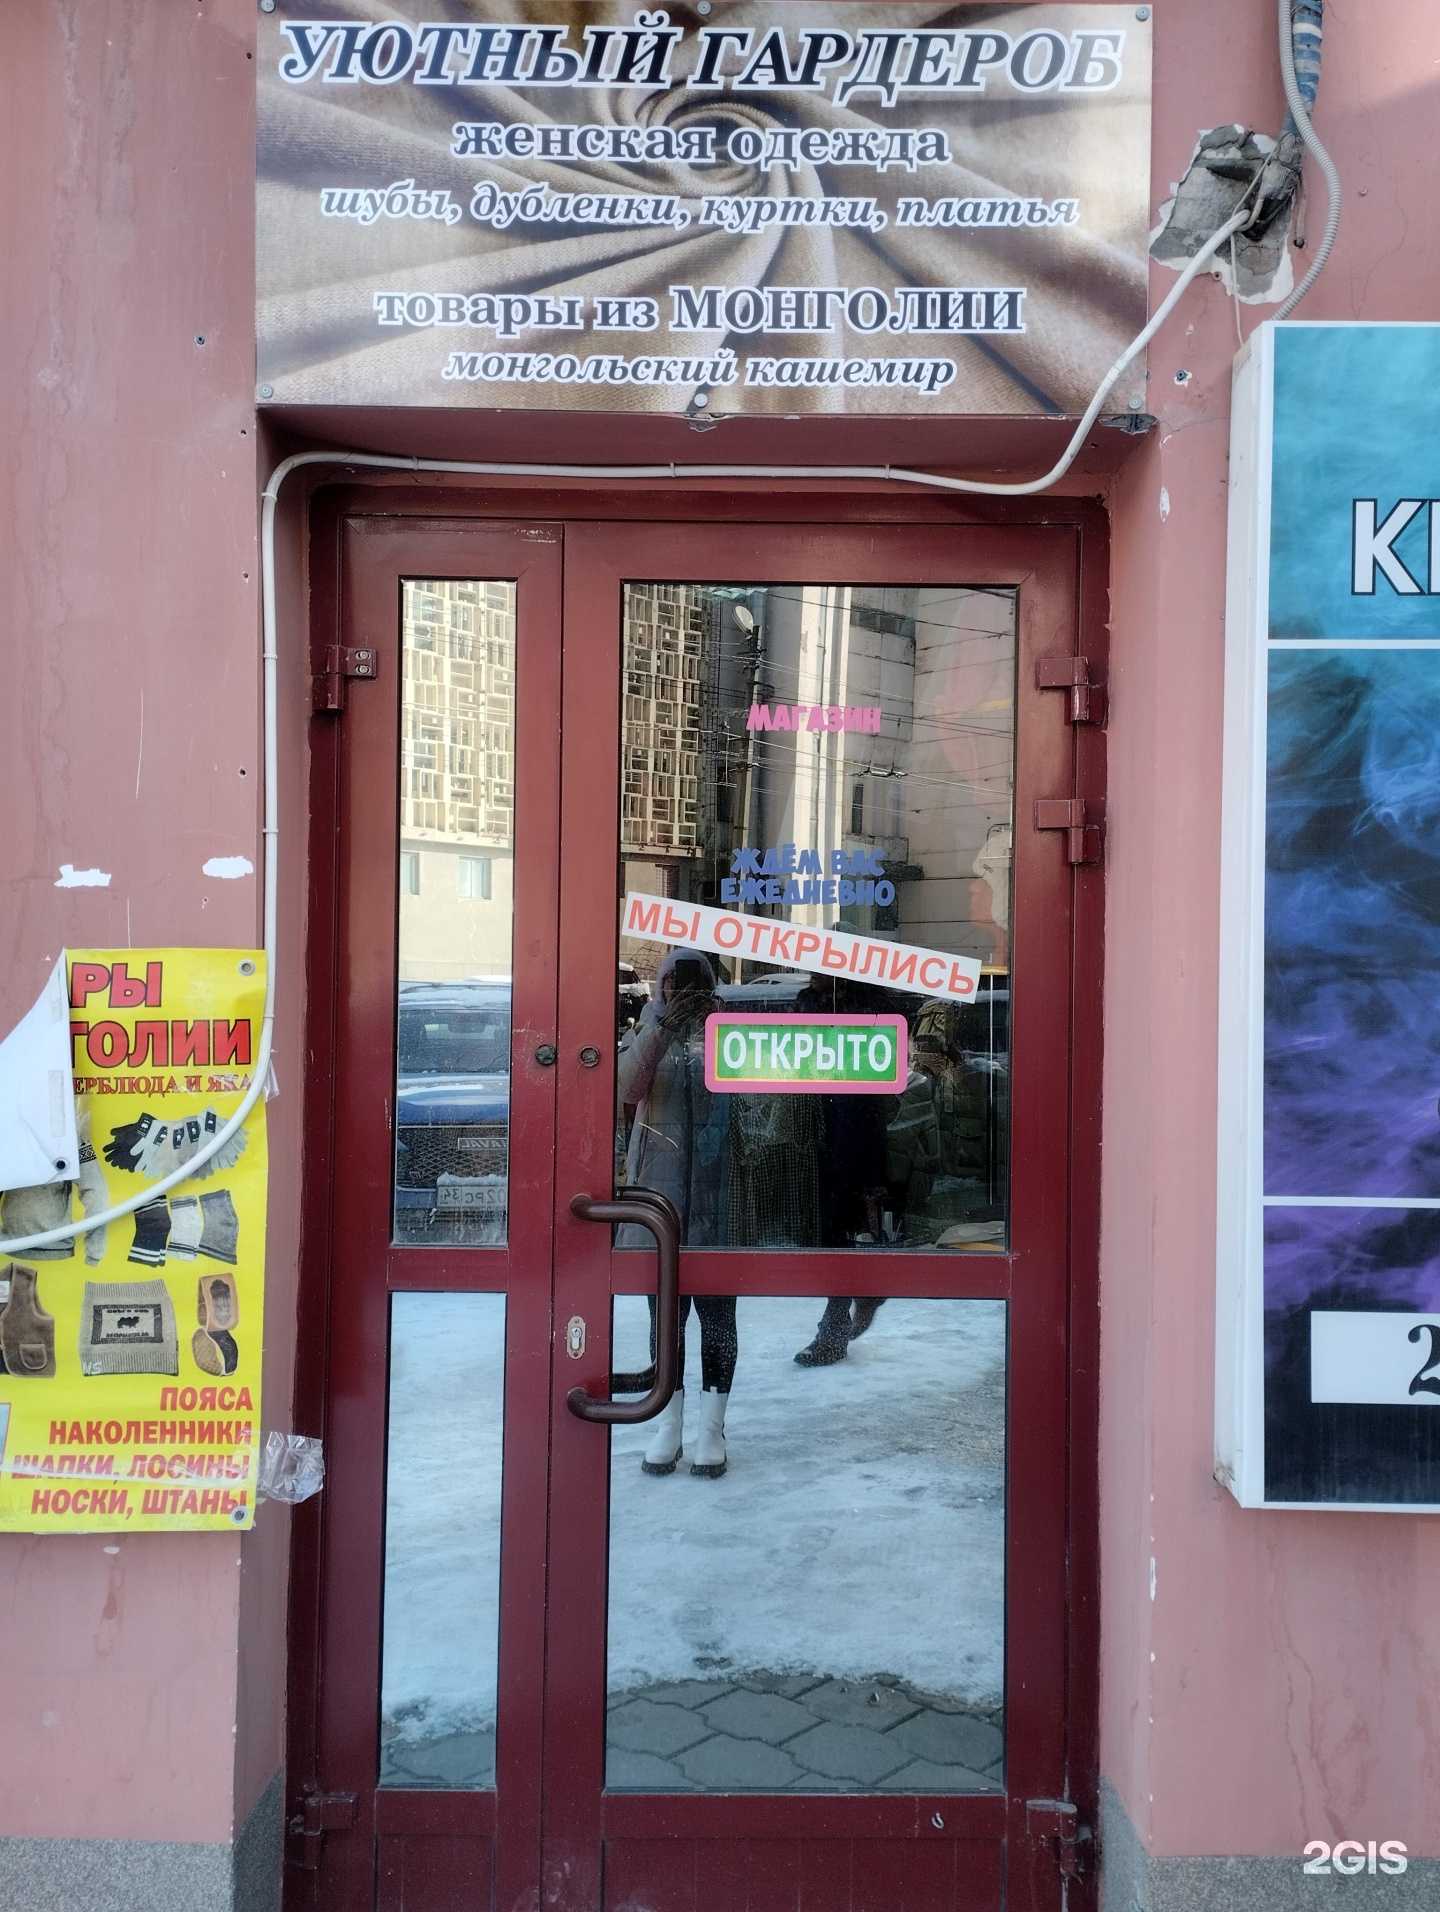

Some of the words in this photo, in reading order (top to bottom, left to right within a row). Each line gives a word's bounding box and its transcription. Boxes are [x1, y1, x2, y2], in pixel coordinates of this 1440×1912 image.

[280, 11, 682, 88] УЮТНЫЙ
[687, 28, 1126, 106] ГАРДЕРОБ
[452, 123, 717, 159] женская
[729, 127, 950, 171] одежда
[322, 179, 463, 225] шубы,
[471, 181, 691, 229] дубленки,
[700, 198, 887, 233] куртки,
[897, 198, 1080, 228] платья
[375, 292, 583, 337] товары
[594, 295, 659, 330] из
[670, 286, 1025, 333] МОНГОЛИИ
[443, 349, 738, 387] монгольский
[745, 356, 956, 395] кашемир
[746, 704, 881, 733] МАГАЗИН
[730, 843, 823, 876] ЖДЁМ
[831, 848, 886, 876] ВАС
[720, 877, 896, 907] ЕЖЕДНЕВНО
[627, 900, 702, 942] МЫ
[713, 914, 976, 996] ОТКРЫЛИСЬ
[69, 961, 163, 1008] РЫ
[70, 1019, 252, 1068] ГОЛИИ
[722, 1031, 893, 1073] ОТКРЫТО
[72, 1075, 177, 1097] ЕРБЛЮДА
[160, 1387, 253, 1411] ПОЯСА
[50, 1421, 252, 1445] НАКОЛЕННИКИ
[127, 1454, 250, 1480] ЛОСИНЫ
[31, 1489, 133, 1521] НОСКИ,
[141, 1489, 248, 1516] ШТАНЫ
